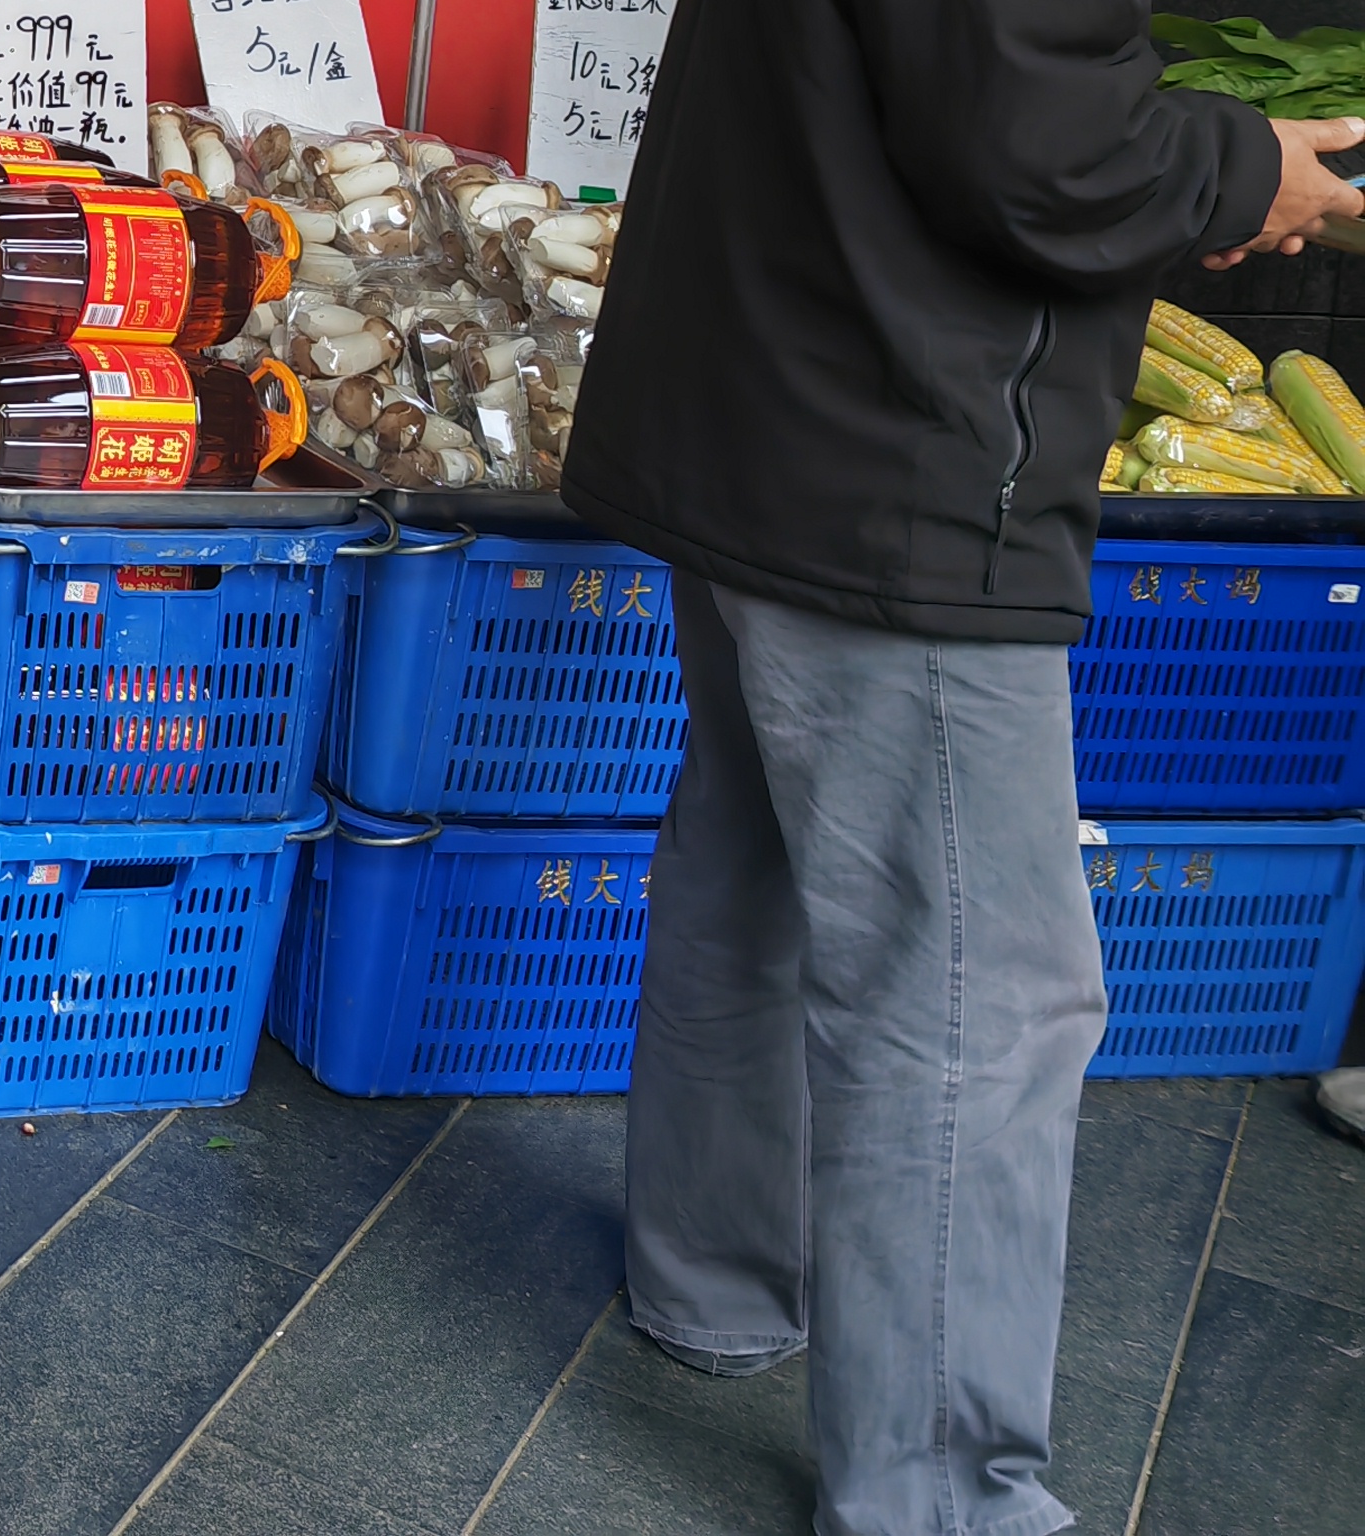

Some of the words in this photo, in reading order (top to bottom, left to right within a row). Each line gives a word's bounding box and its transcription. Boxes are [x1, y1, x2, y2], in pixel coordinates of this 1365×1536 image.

[99, 432, 184, 465] 胡姬花
[567, 568, 653, 619] 钱大
[1128, 566, 1263, 606] 钱大妈
[1084, 850, 1216, 894] 钱大妈
